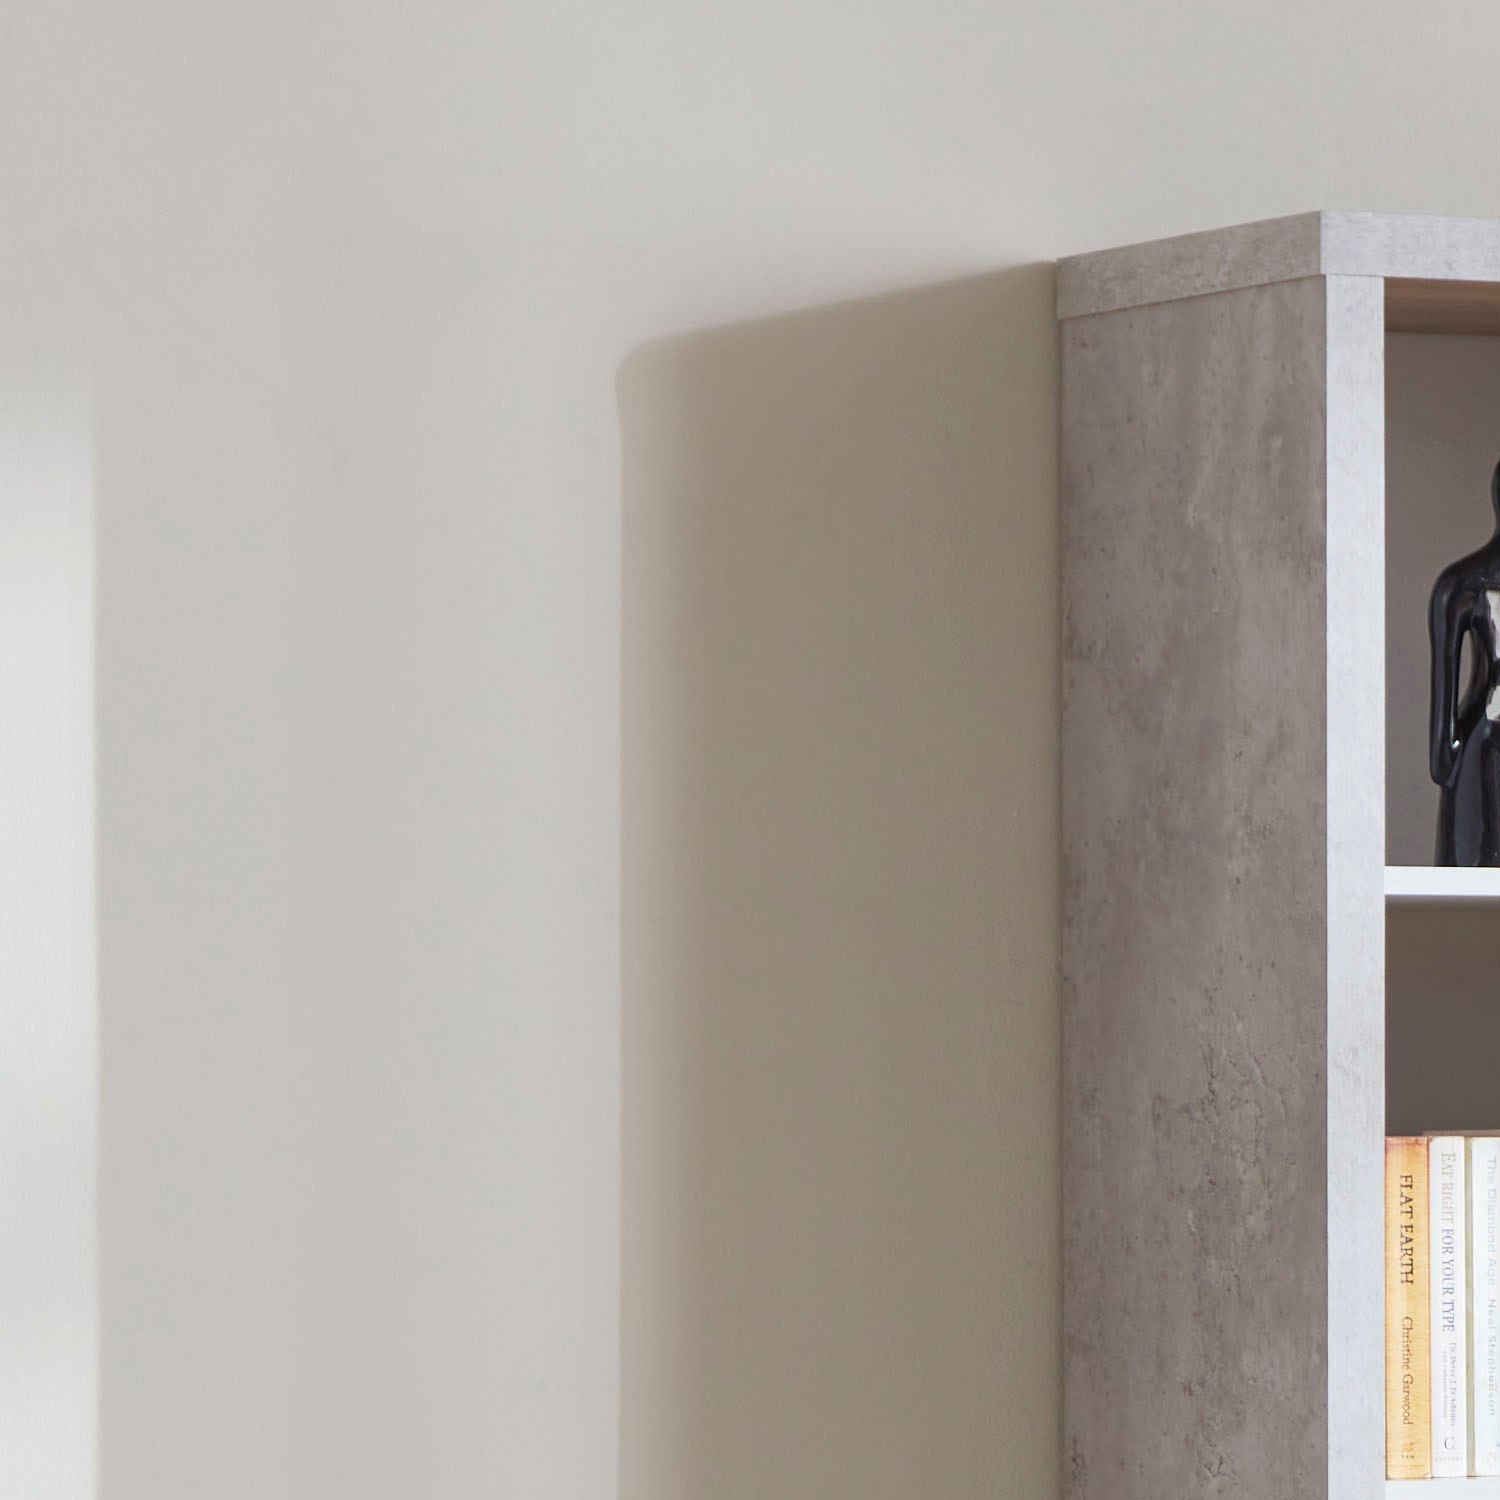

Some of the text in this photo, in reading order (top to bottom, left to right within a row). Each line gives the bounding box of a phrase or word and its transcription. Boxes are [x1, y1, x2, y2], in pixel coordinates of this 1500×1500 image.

[1399, 1174, 1414, 1285] FLAT EARTH
[1441, 1152, 1456, 1332] EAT RIGHT FOR YOUR TYPE
[1486, 1157, 1498, 1416] The Diamond Age Neal Stephenson
[1402, 1316, 1414, 1425] Christine Garwood
